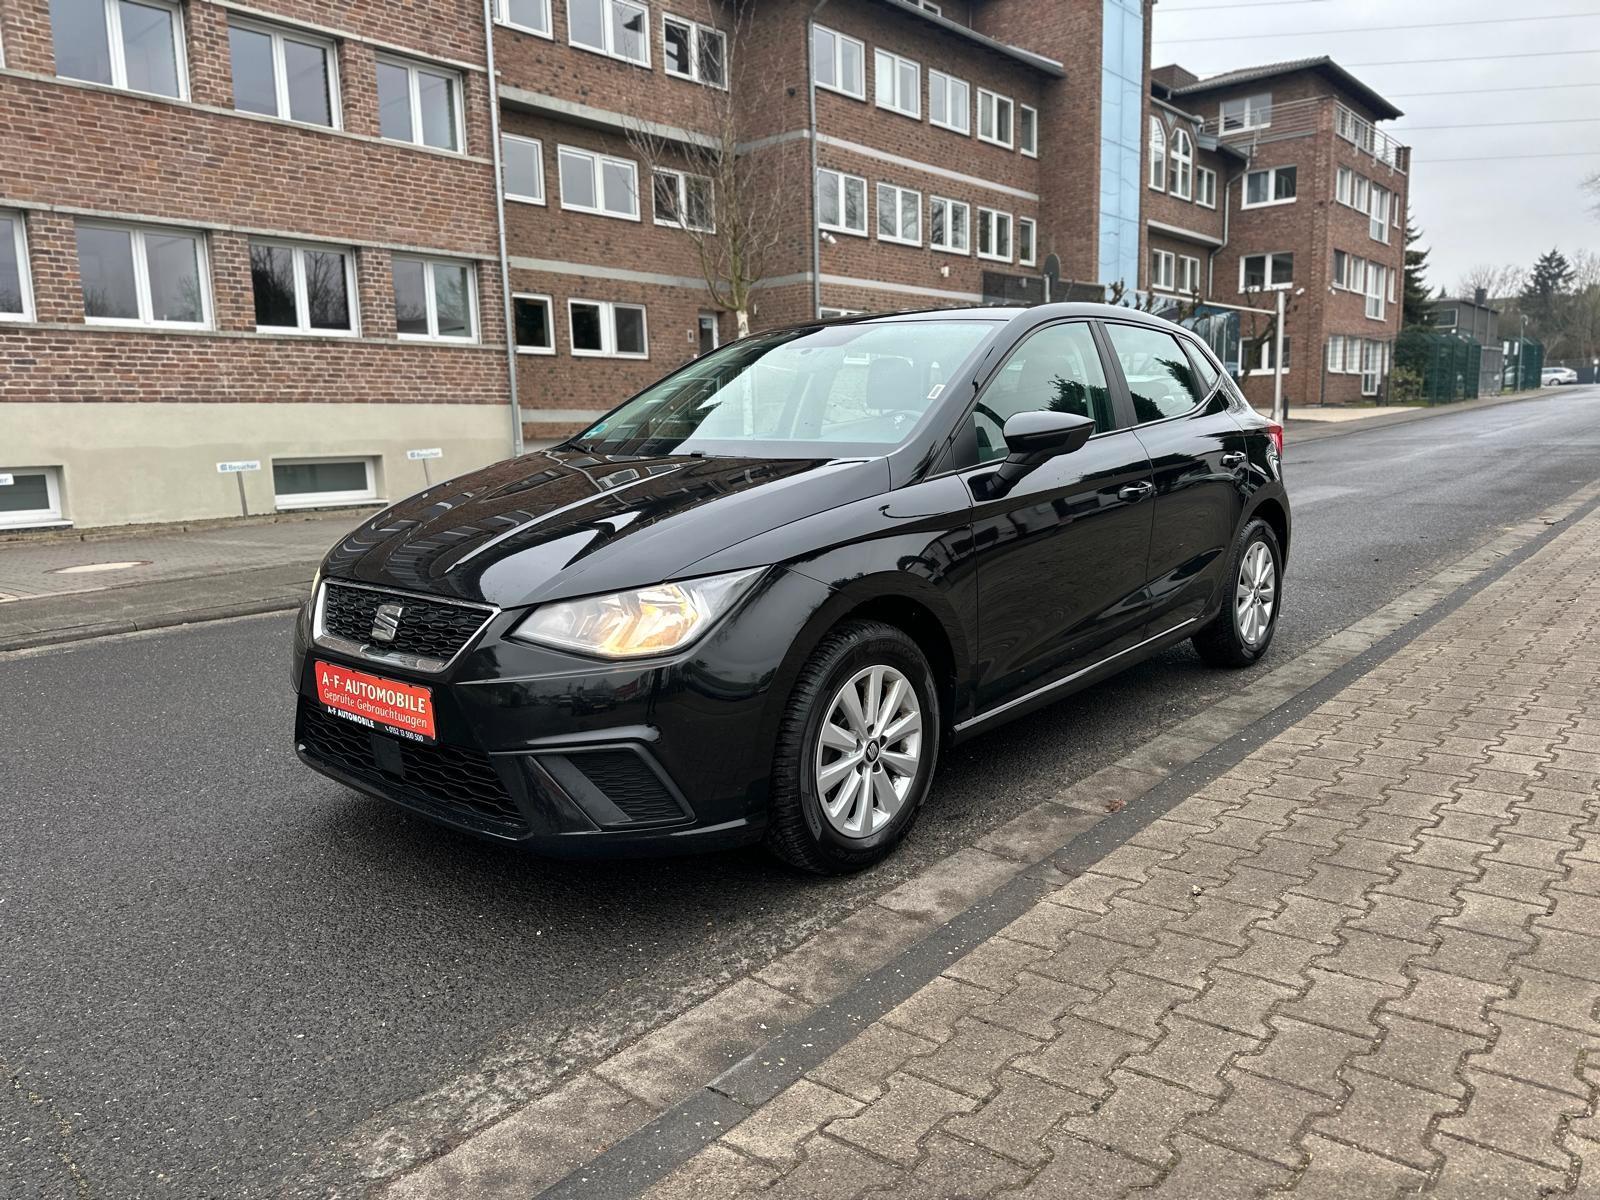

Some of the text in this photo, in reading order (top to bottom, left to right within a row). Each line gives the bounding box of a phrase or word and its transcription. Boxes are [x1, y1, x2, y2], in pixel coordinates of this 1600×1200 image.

[322, 671, 426, 714] A-F-AUTOMOBILE
[323, 688, 428, 729] Geprüfte Gebrauchtwagen
[337, 709, 375, 729] AUTOMOBILE
